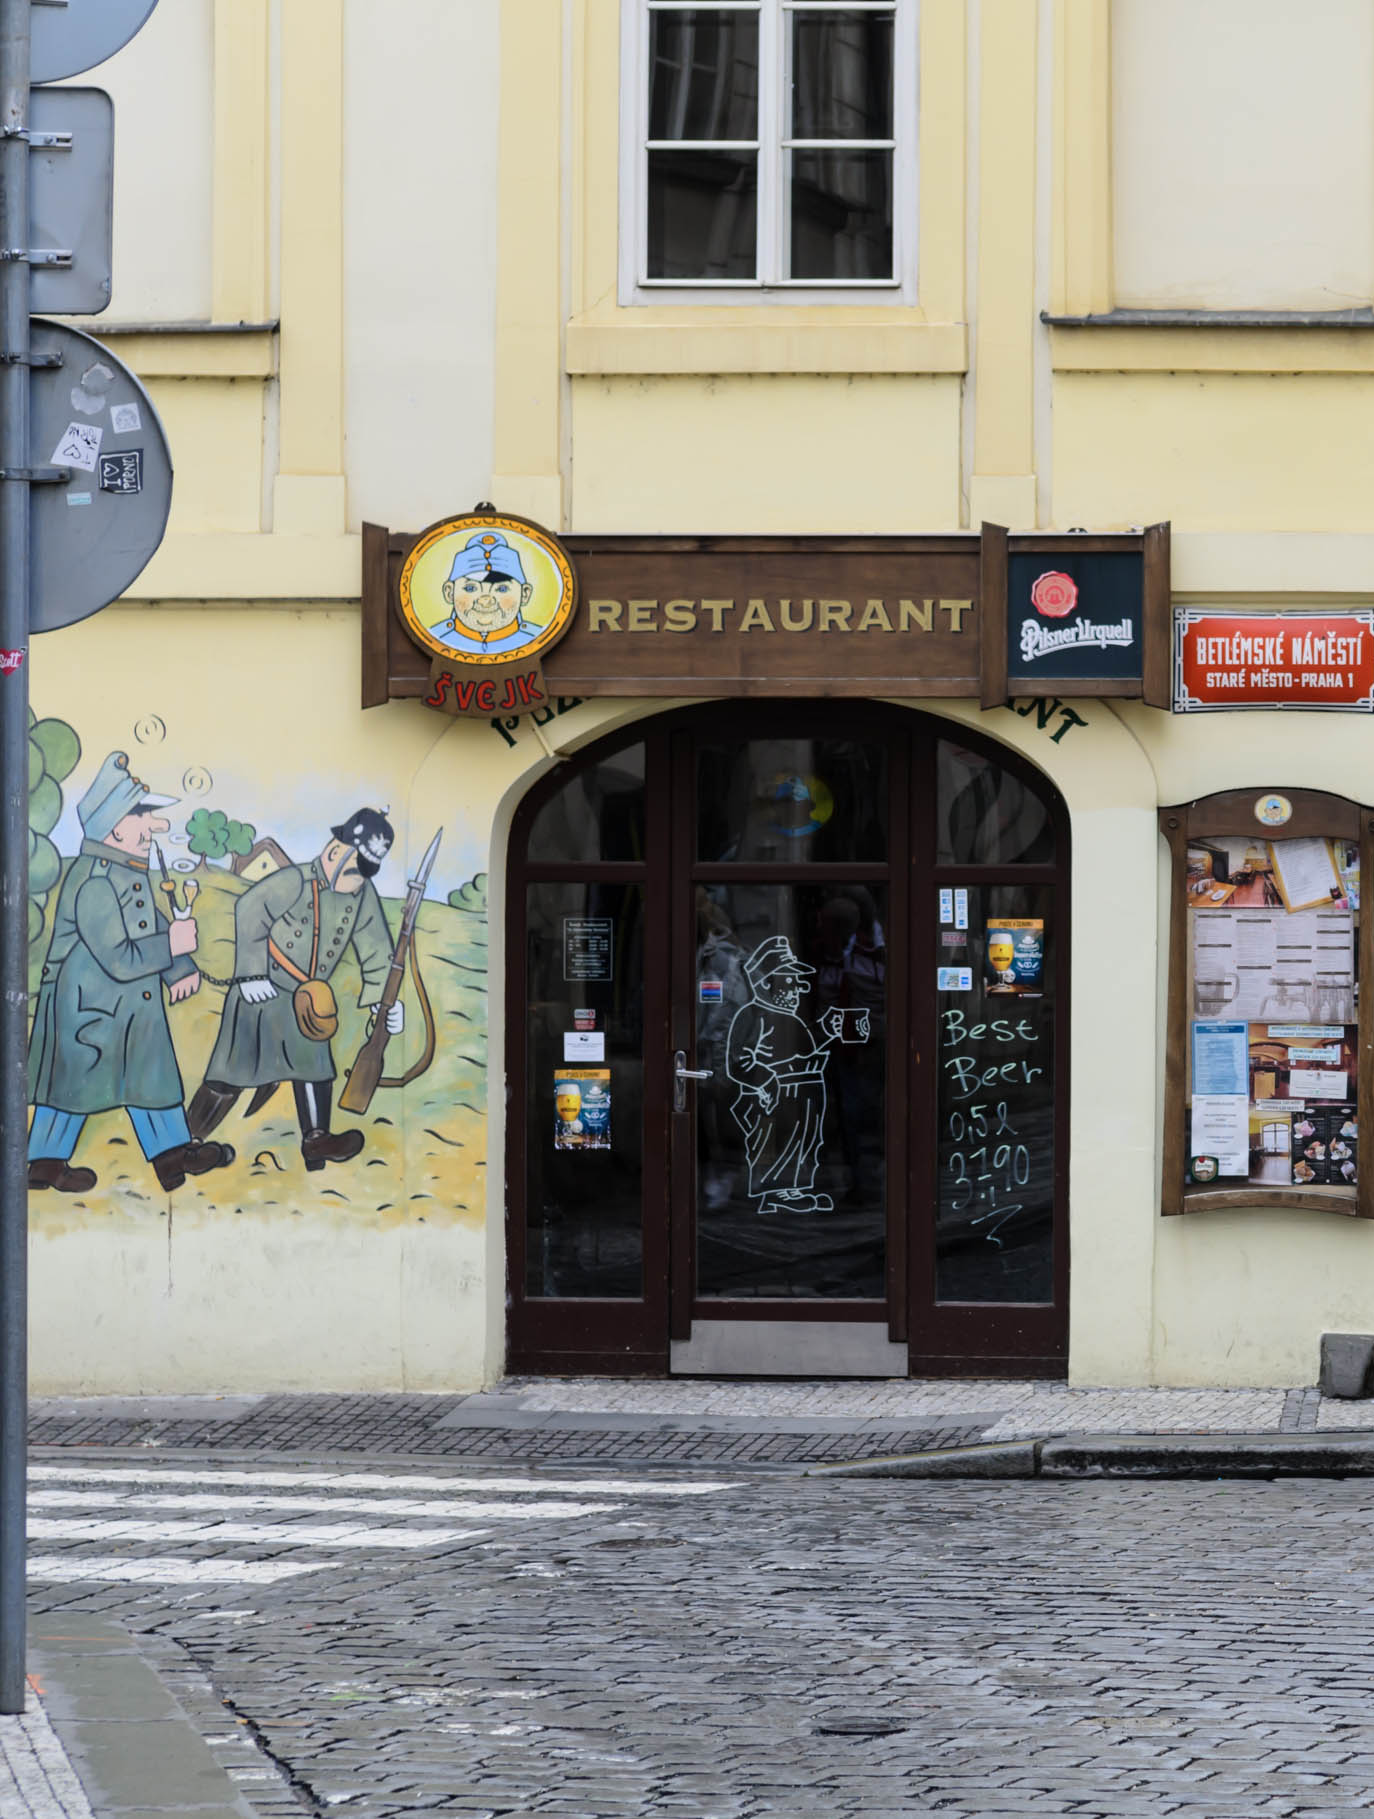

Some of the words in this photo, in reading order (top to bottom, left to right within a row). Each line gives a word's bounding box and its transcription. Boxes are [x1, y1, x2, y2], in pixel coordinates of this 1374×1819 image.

[588, 599, 973, 633] RESTAURANT
[1020, 619, 1078, 662] Pilsner
[1075, 617, 1134, 649] Urquell
[1197, 631, 1285, 665] BETLÉMSKÉ
[1292, 631, 1364, 665] NÁMĚSTÍ
[426, 671, 544, 712] ŠVEJK
[1206, 668, 1246, 688] STARÉ
[1348, 673, 1354, 688] 1
[940, 1009, 1039, 1046] Best
[944, 1056, 1043, 1100] Beer
